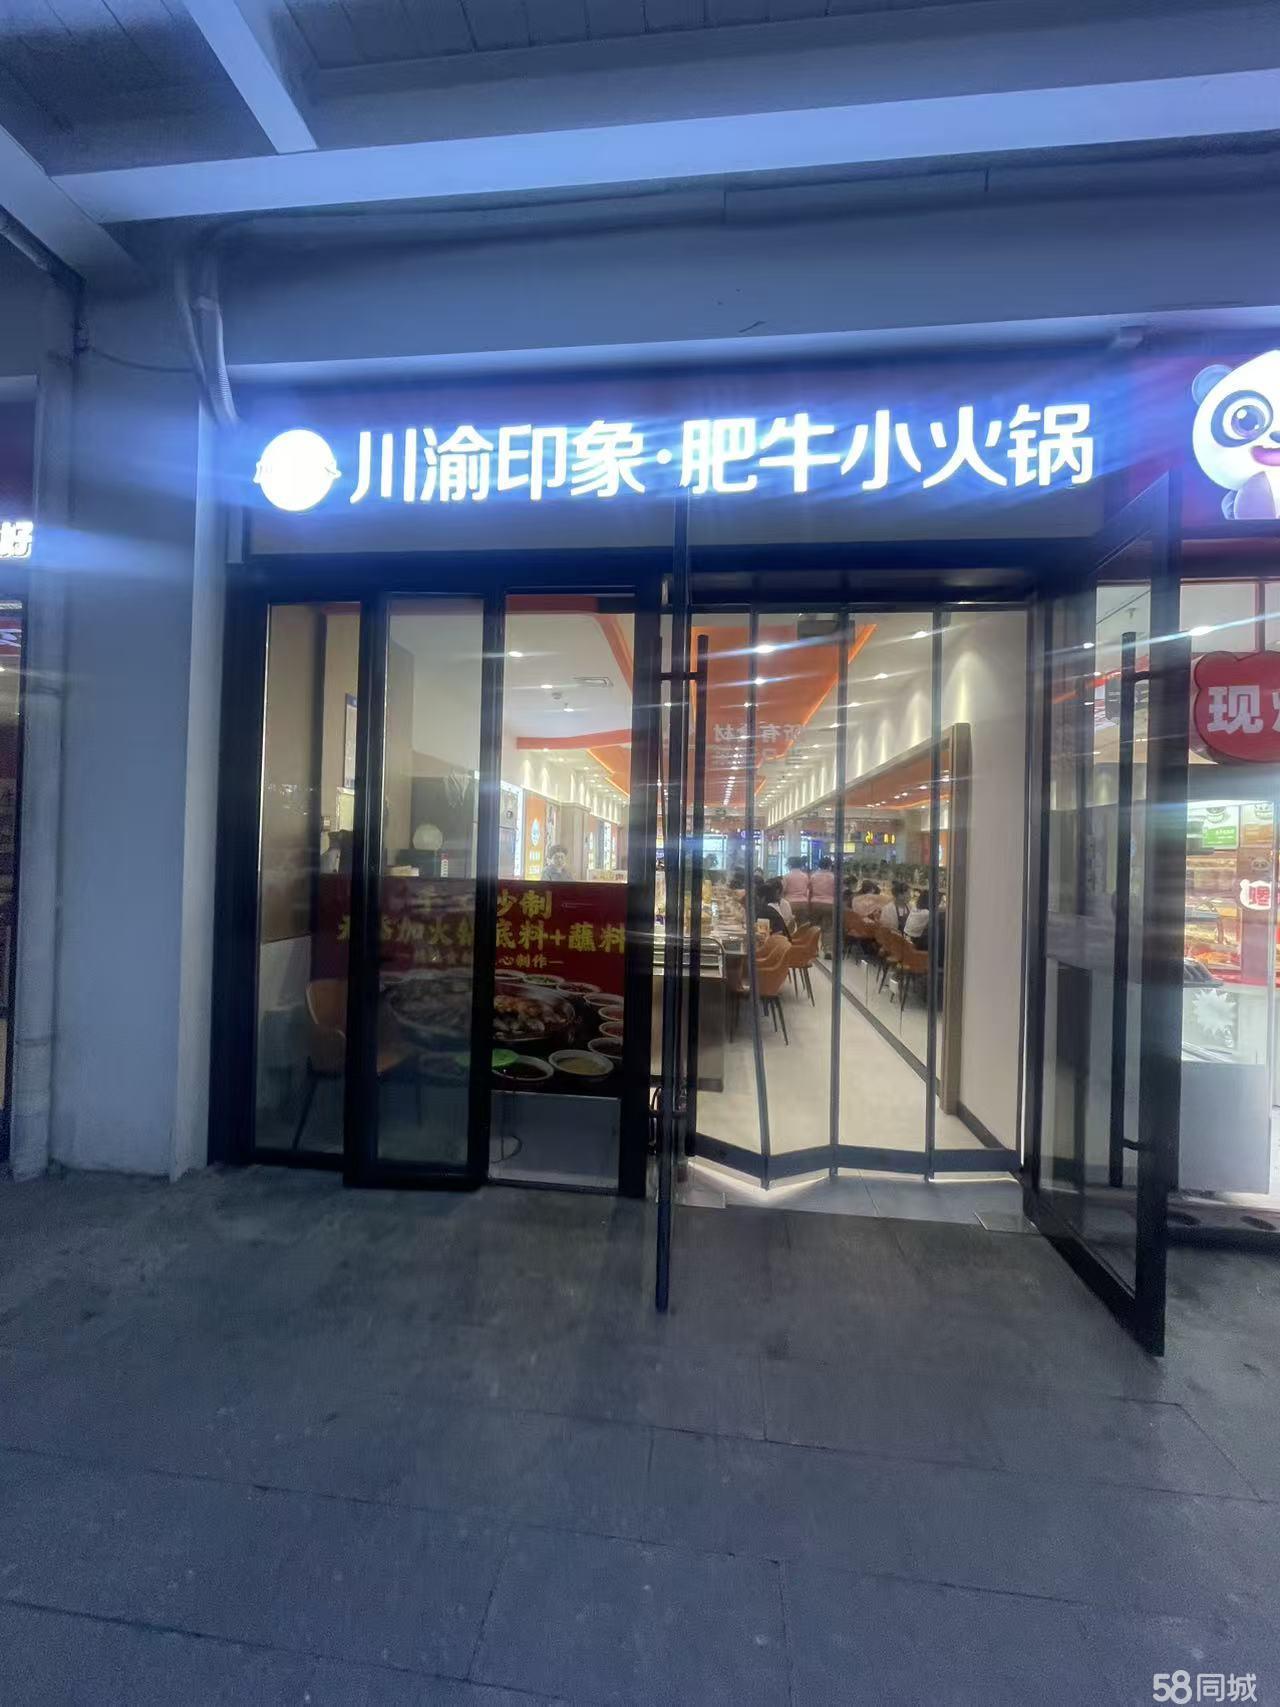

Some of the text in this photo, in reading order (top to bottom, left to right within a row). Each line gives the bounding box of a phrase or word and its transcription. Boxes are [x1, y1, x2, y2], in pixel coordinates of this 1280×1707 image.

[349, 403, 1095, 504] 川渝印象·肥牛小火锅
[1206, 685, 1280, 734] 现
